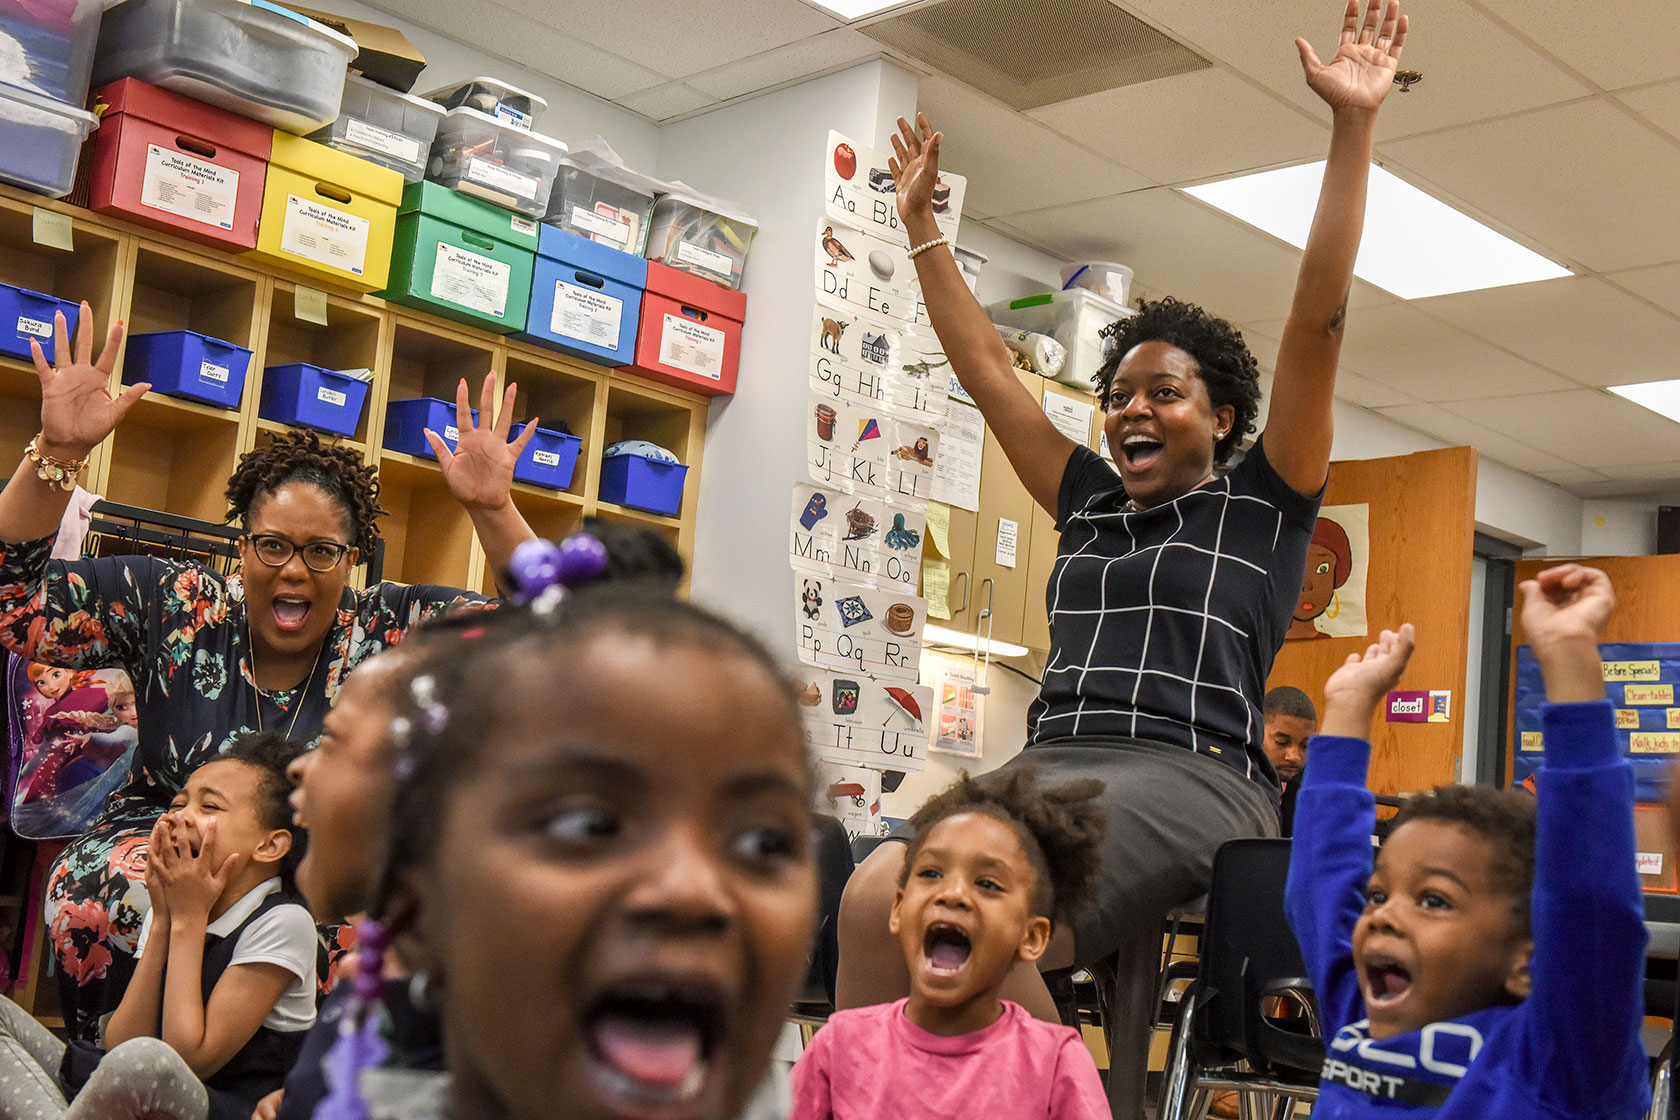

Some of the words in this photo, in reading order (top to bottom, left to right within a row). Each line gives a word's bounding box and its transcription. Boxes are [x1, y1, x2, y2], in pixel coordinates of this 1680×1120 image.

[832, 185, 855, 213] Aa
[873, 199, 898, 230] Bb
[823, 269, 848, 300] Dd
[868, 286, 890, 315] Ee
[816, 357, 842, 397] Gg
[858, 371, 885, 401] Hh
[912, 387, 929, 411] Ii
[815, 445, 832, 482] Jj
[852, 457, 877, 486] Kk
[794, 531, 830, 563] Mm
[844, 544, 871, 573] Nn
[887, 556, 911, 583] Oo
[802, 624, 822, 663] Pp
[836, 634, 866, 672] Qq
[884, 642, 911, 668] Rr
[1603, 664, 1627, 677] Before
[1628, 663, 1659, 680] Specials
[1392, 700, 1422, 713] closet
[832, 723, 854, 750] Tt
[880, 729, 914, 758] Uu
